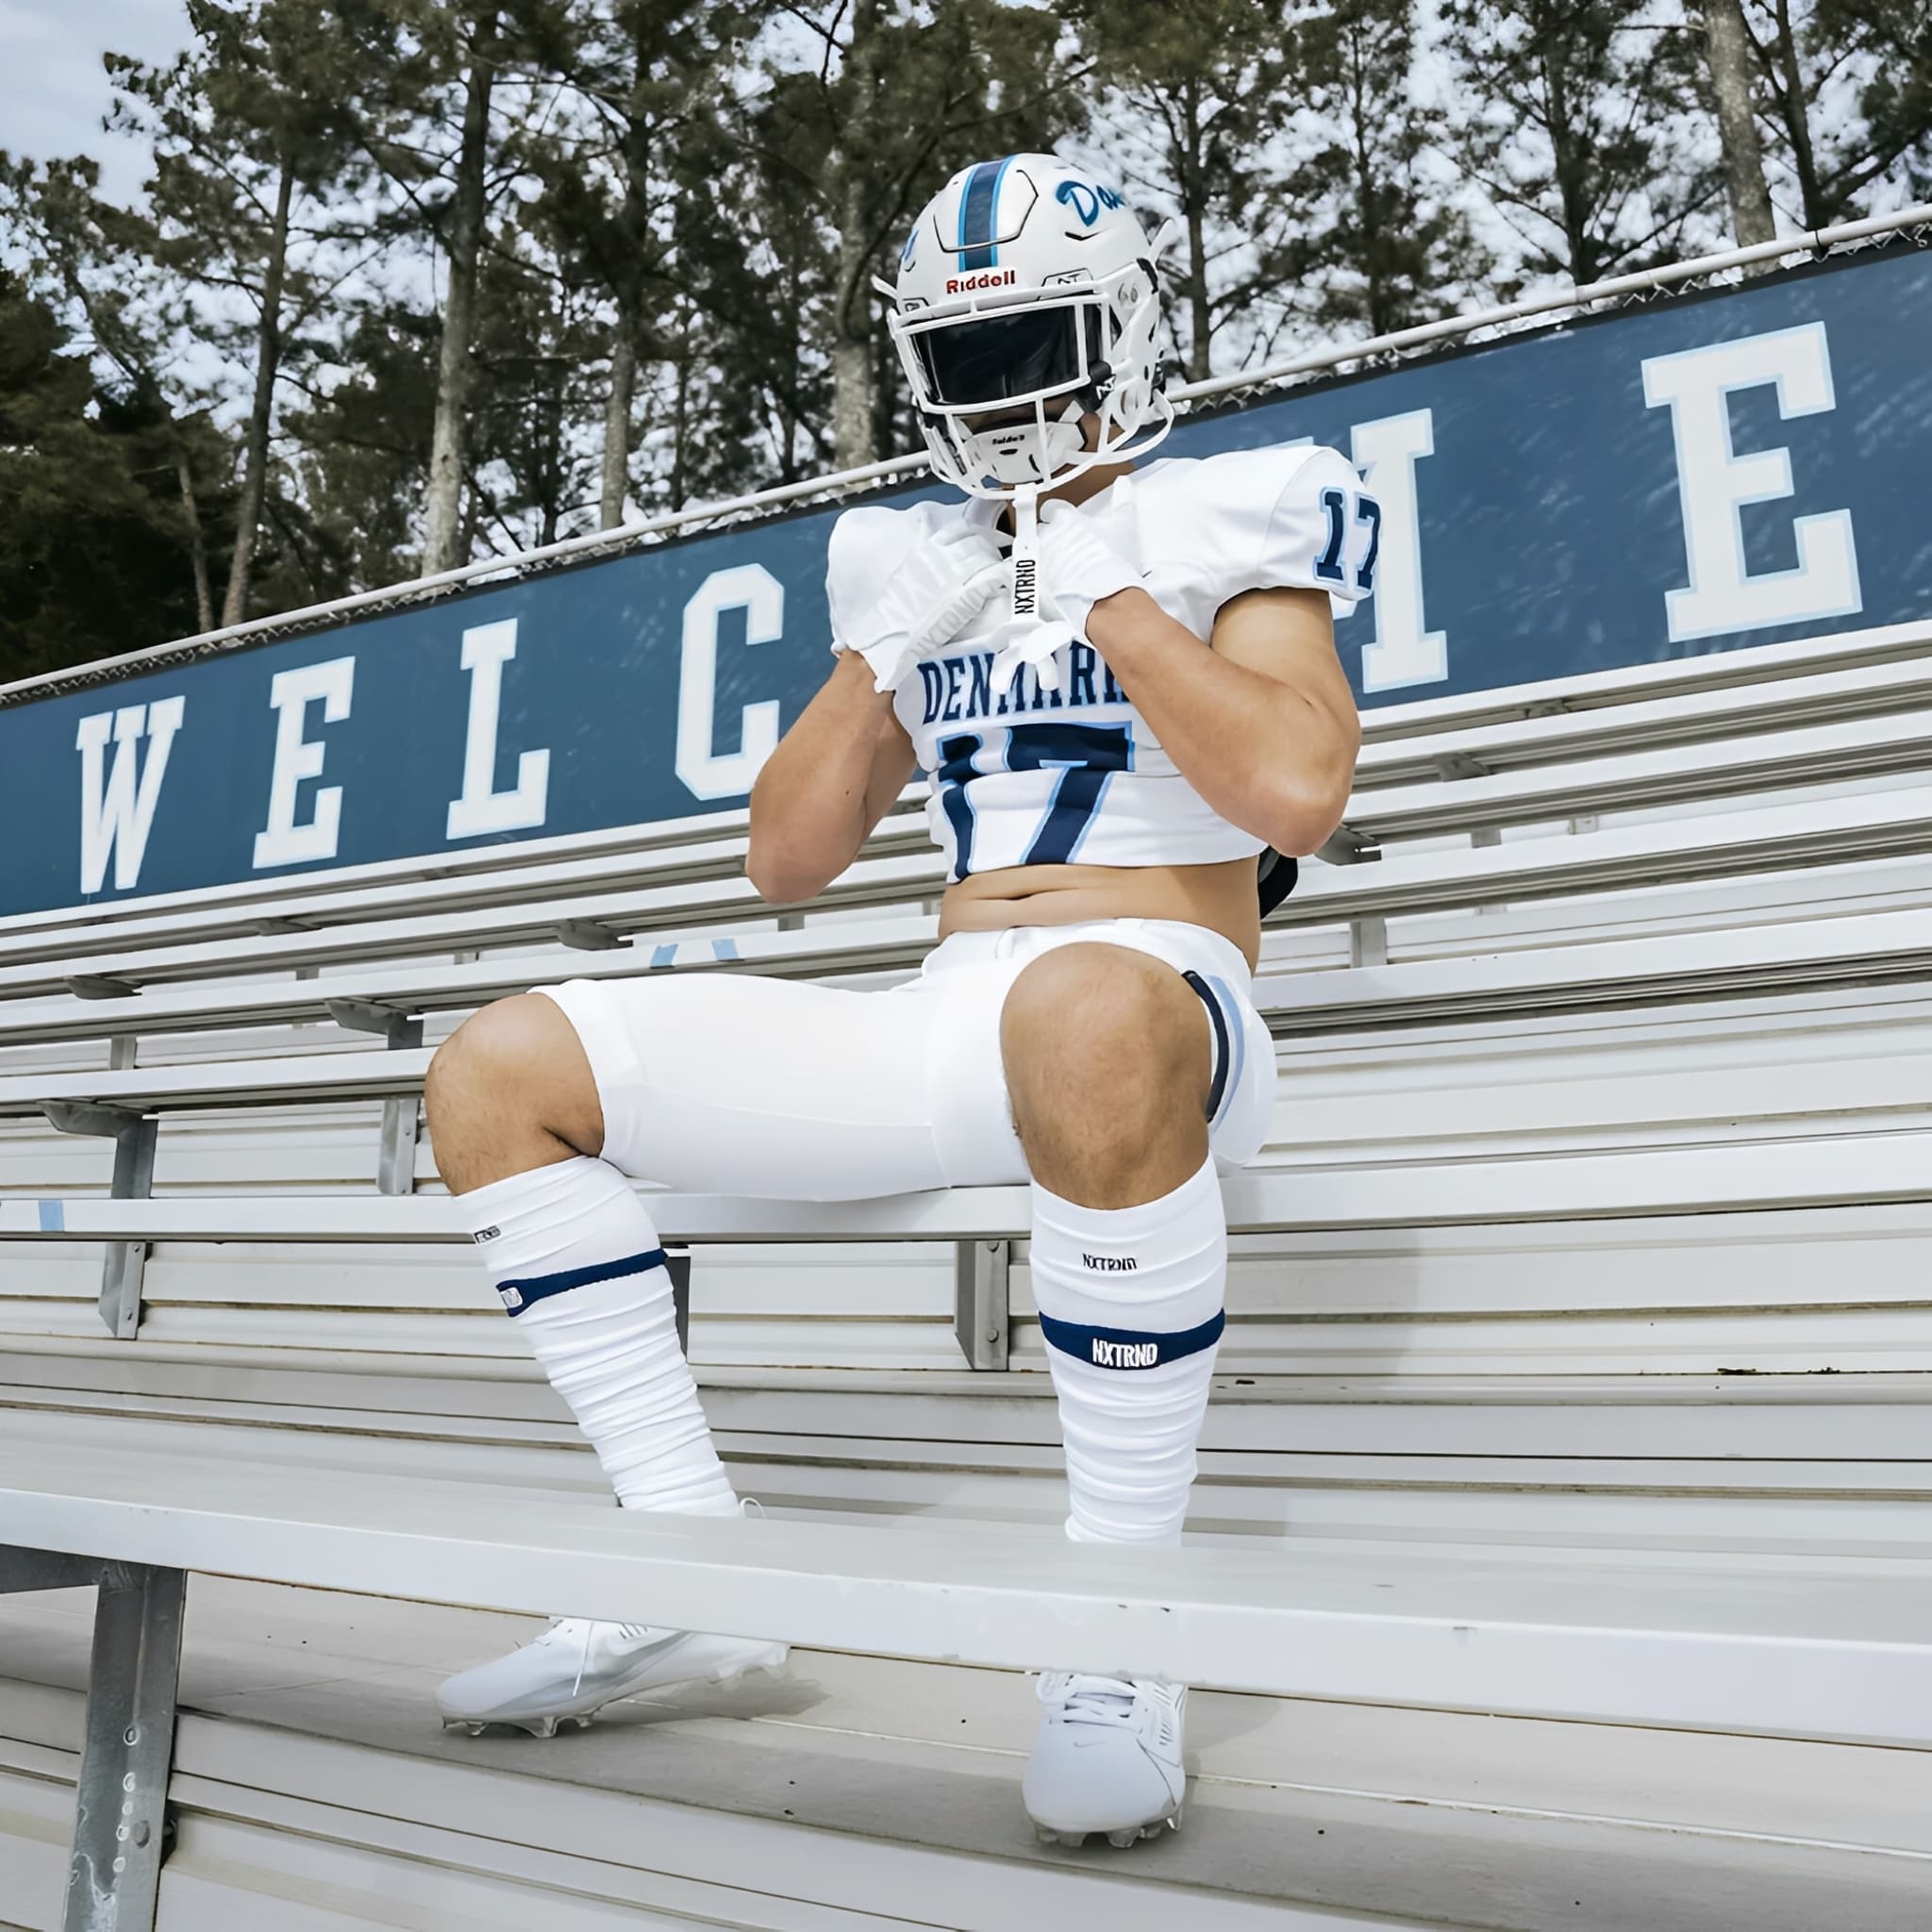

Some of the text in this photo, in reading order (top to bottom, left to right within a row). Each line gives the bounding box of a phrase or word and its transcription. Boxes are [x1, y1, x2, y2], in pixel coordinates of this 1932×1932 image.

[945, 270, 1016, 295] Riddell
[1312, 486, 1382, 596] 17
[1014, 558, 1037, 615] NXTRND
[936, 720, 1136, 880] 17
[1091, 1338, 1158, 1368] NXTRND
